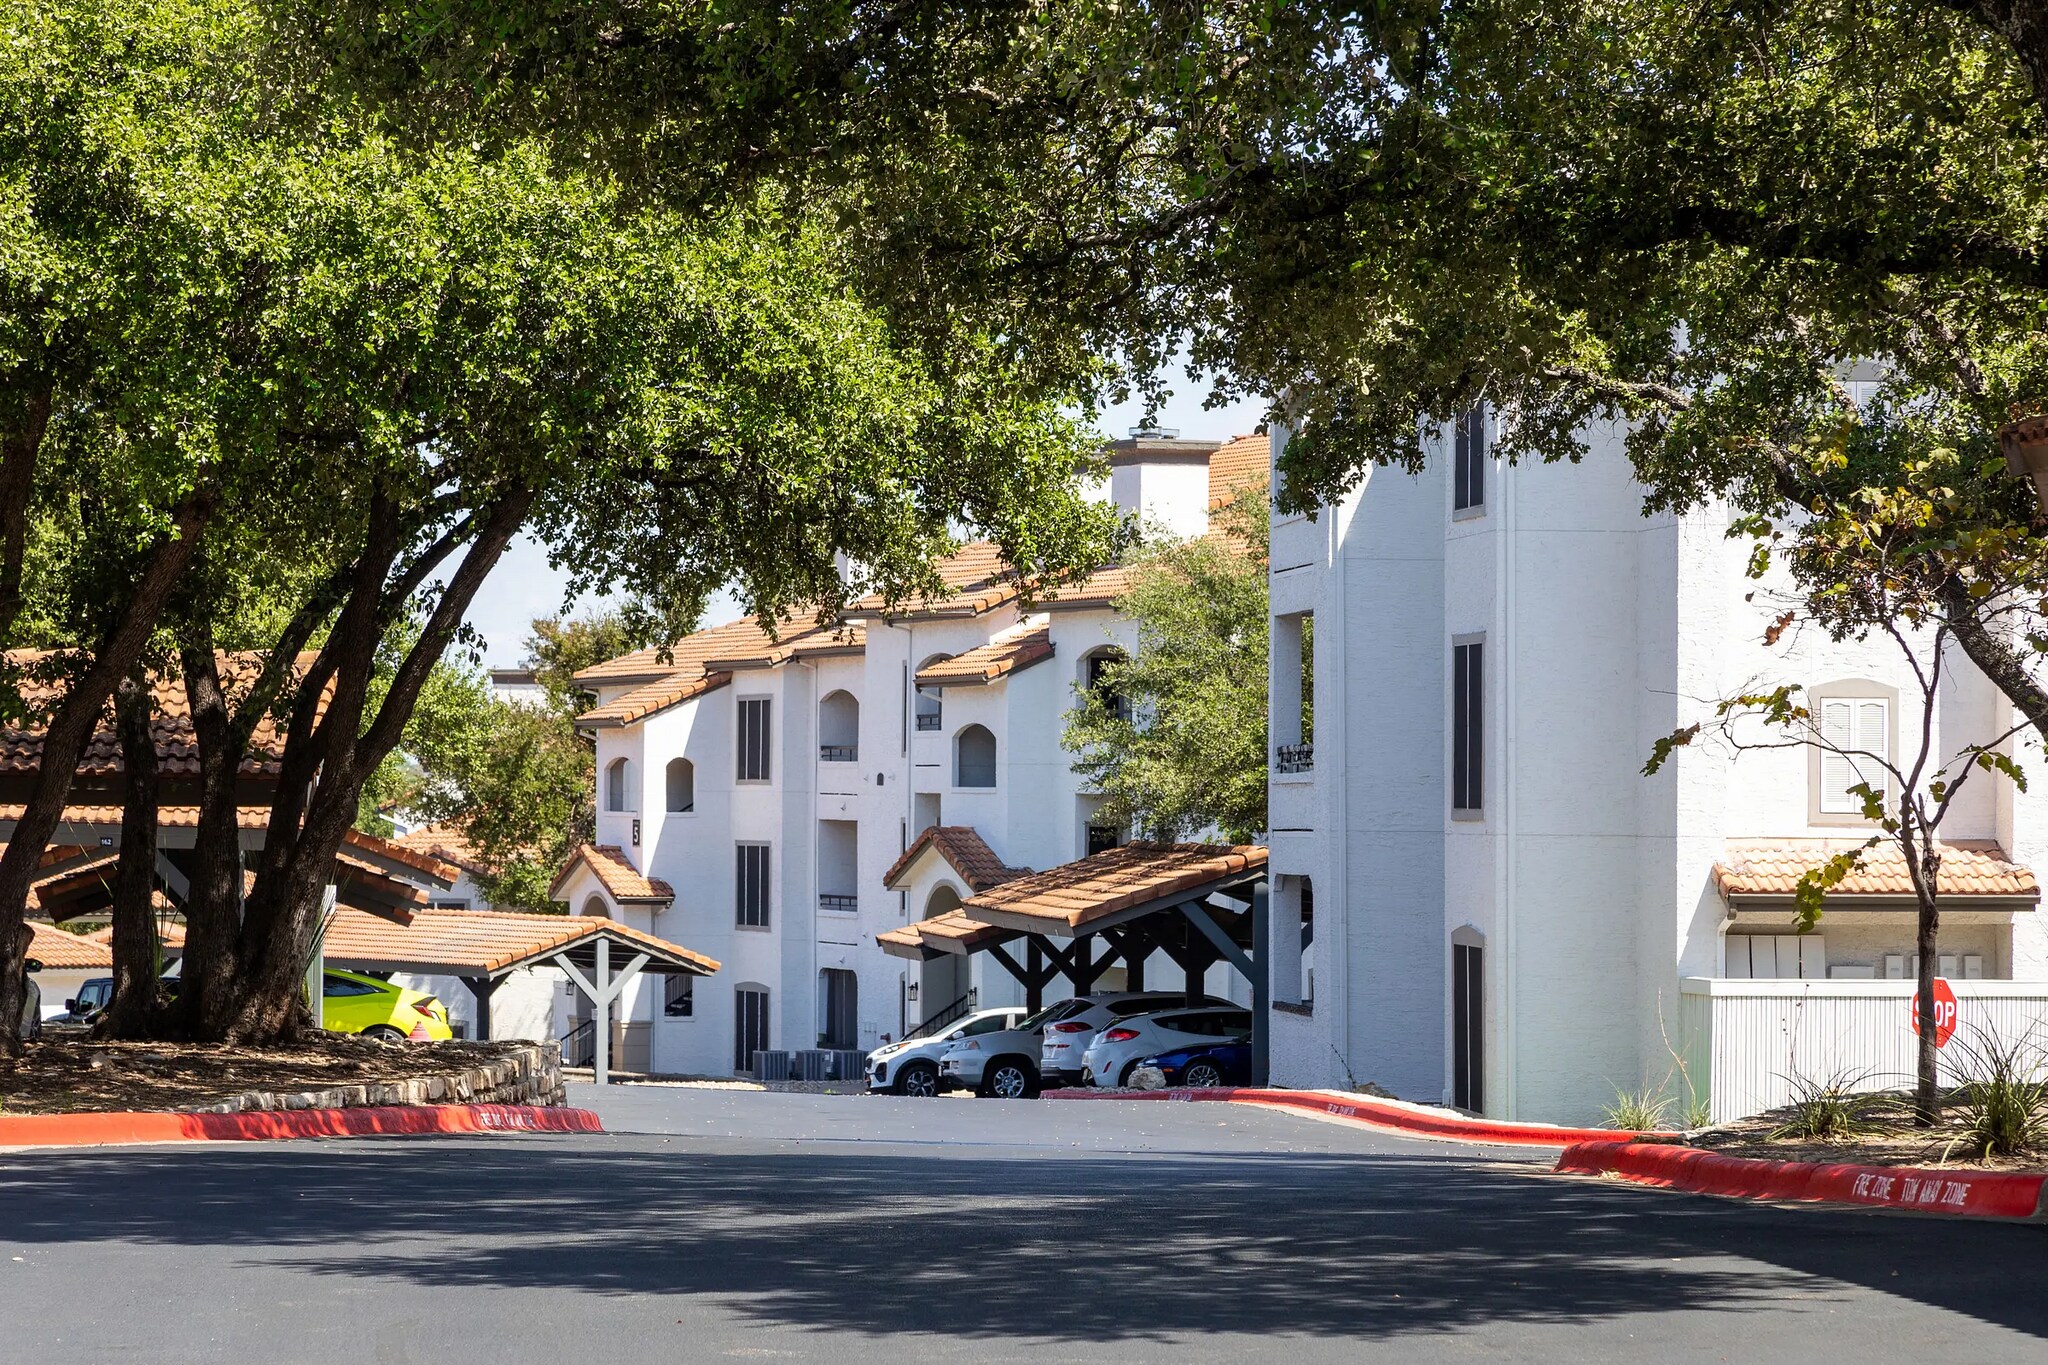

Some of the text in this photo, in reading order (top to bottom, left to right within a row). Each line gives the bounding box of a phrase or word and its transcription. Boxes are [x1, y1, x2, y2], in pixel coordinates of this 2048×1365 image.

[633, 826, 639, 843] 5
[1914, 1000, 1955, 1027] SOP
[1853, 1173, 1971, 1205] FIRE ZONE TOW AWAY ZONE
